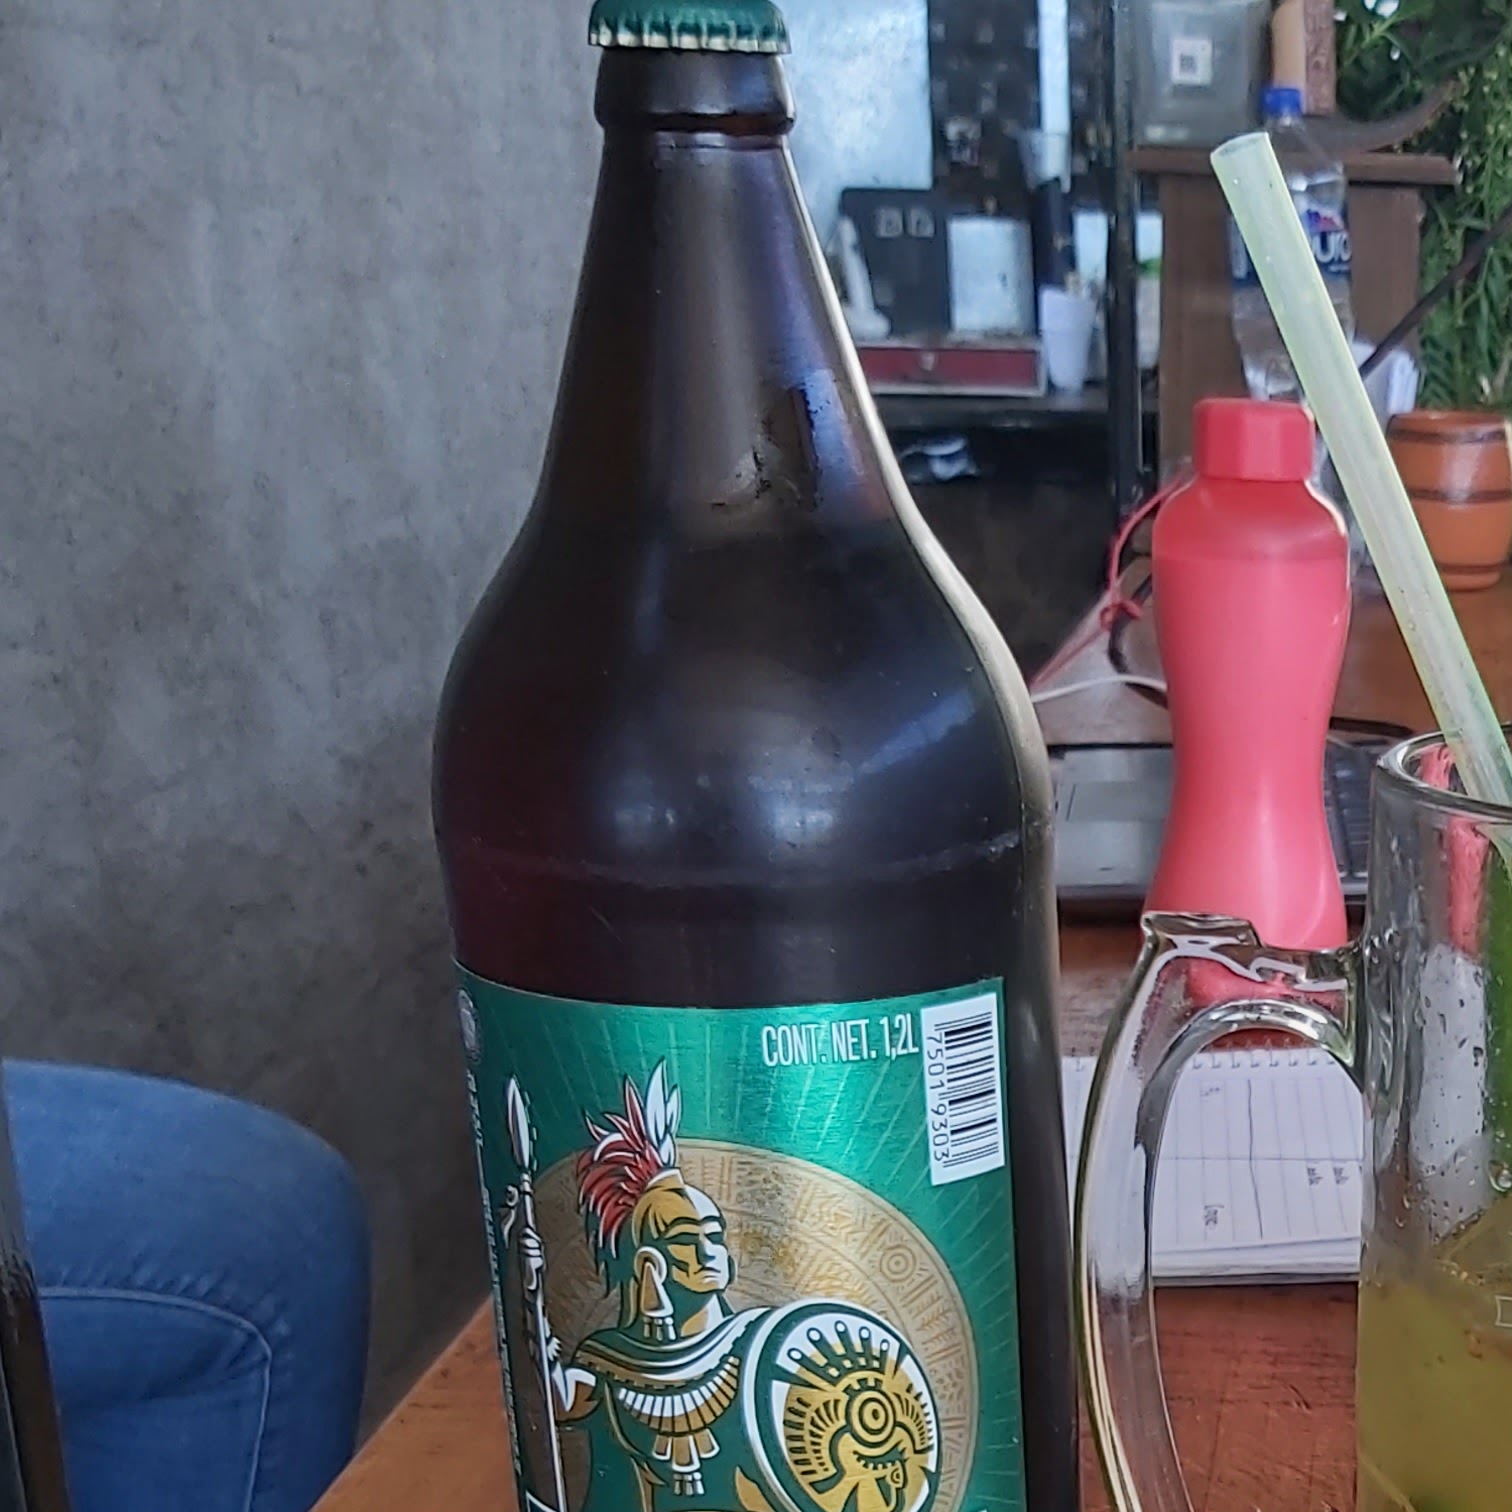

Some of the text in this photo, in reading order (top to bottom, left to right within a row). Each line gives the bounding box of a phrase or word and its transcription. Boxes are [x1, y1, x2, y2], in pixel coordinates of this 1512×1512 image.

[762, 1012, 919, 1068] CONT. NET. 1,2L
